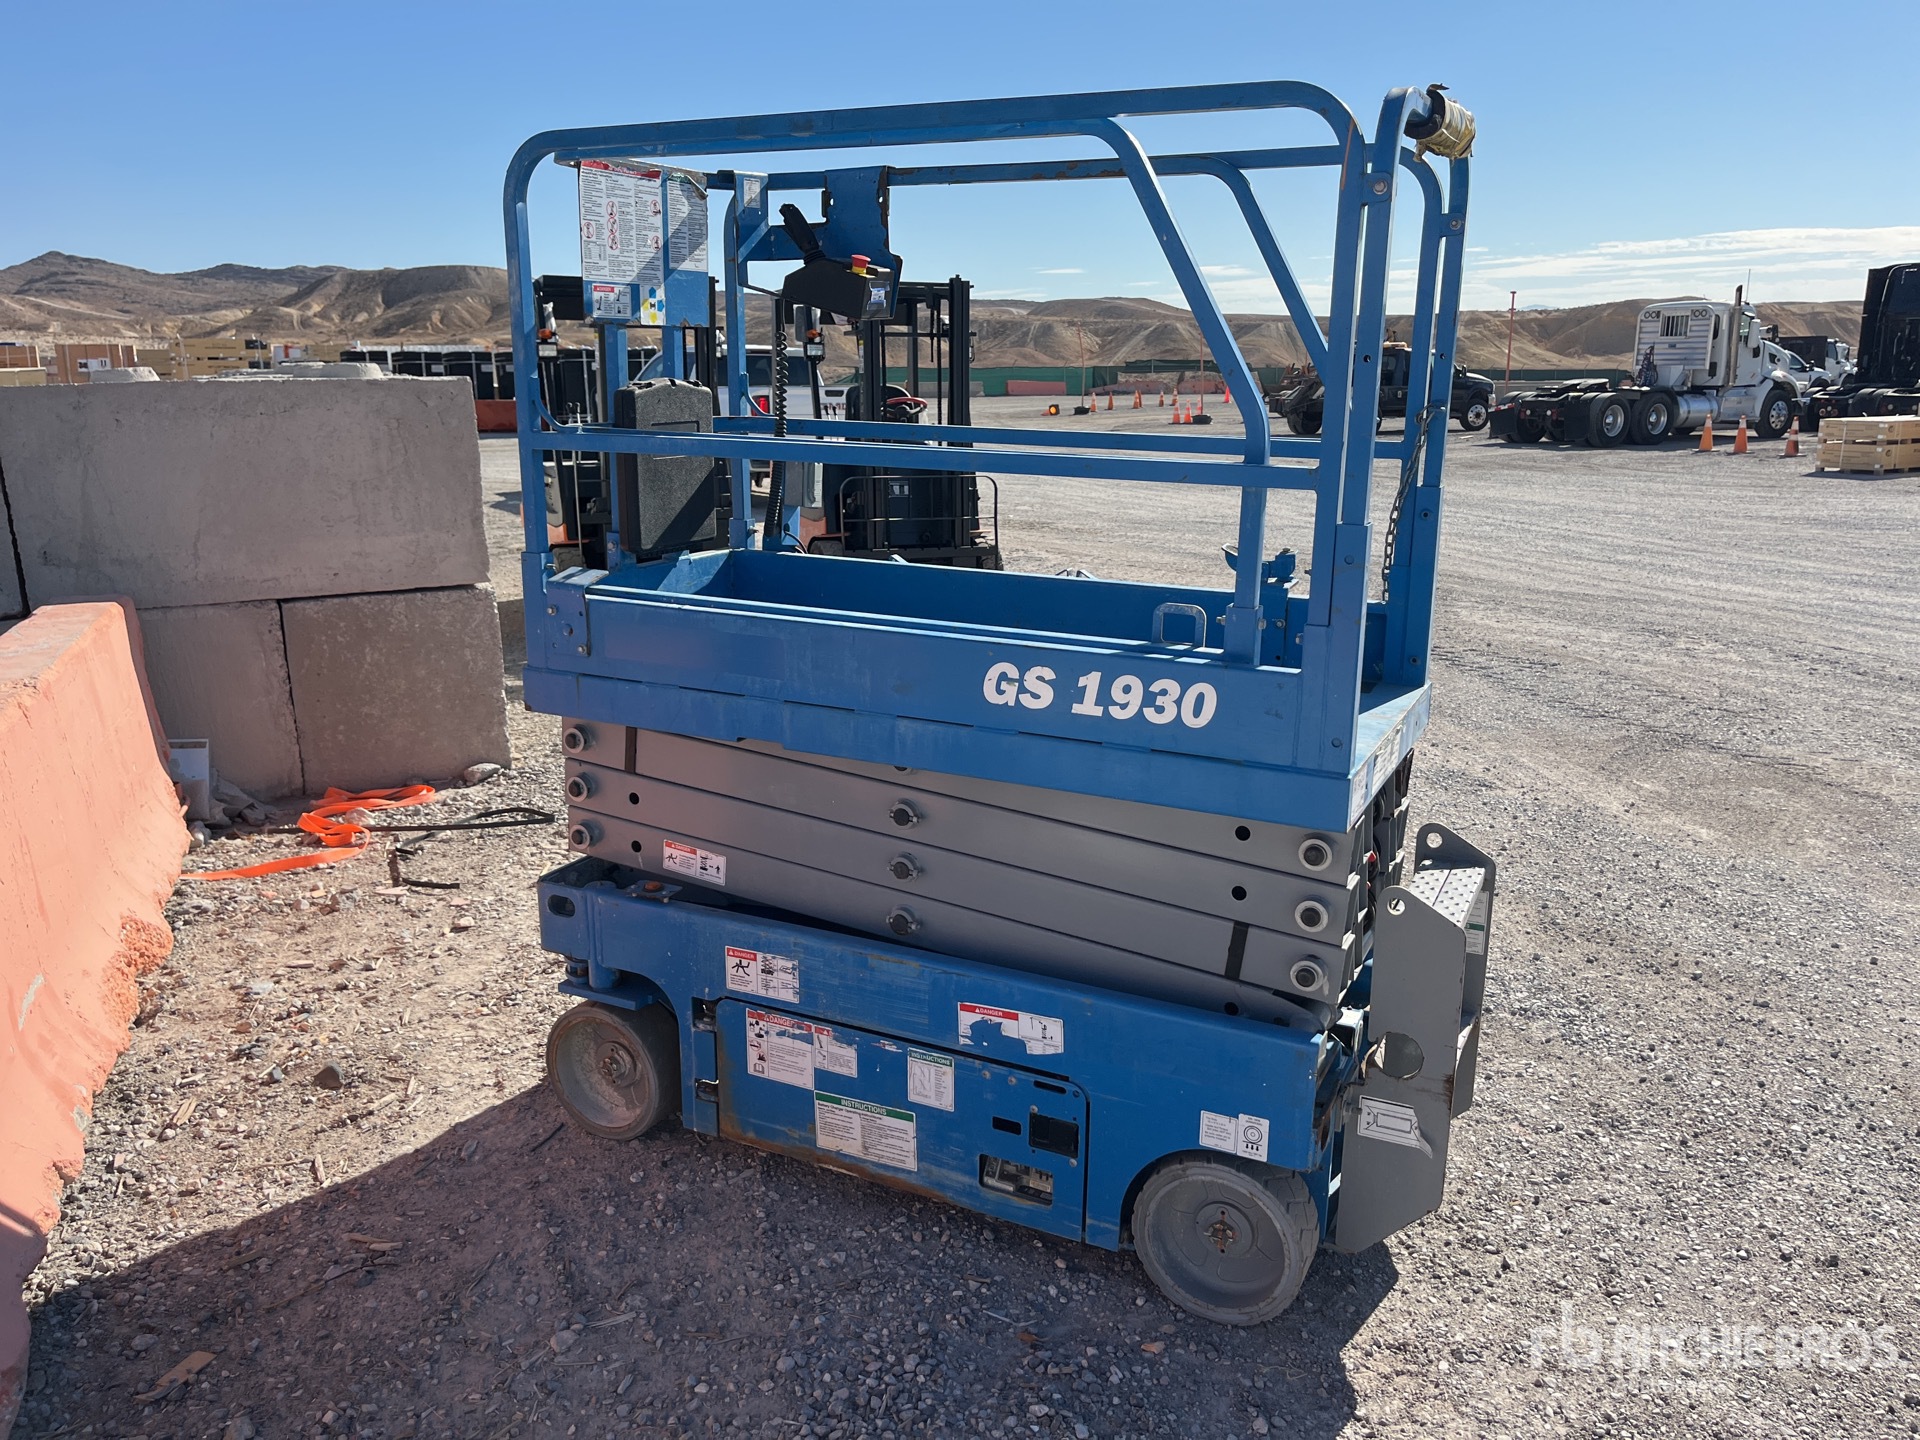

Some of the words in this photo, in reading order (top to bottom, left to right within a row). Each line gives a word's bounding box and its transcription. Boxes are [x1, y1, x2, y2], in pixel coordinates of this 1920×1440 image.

[983, 661, 1057, 710] GS
[1071, 671, 1218, 729] 1930
[734, 950, 755, 959] DANGER
[980, 1008, 1003, 1017] DANGER
[841, 1099, 887, 1115] INSTRUCTIONS
